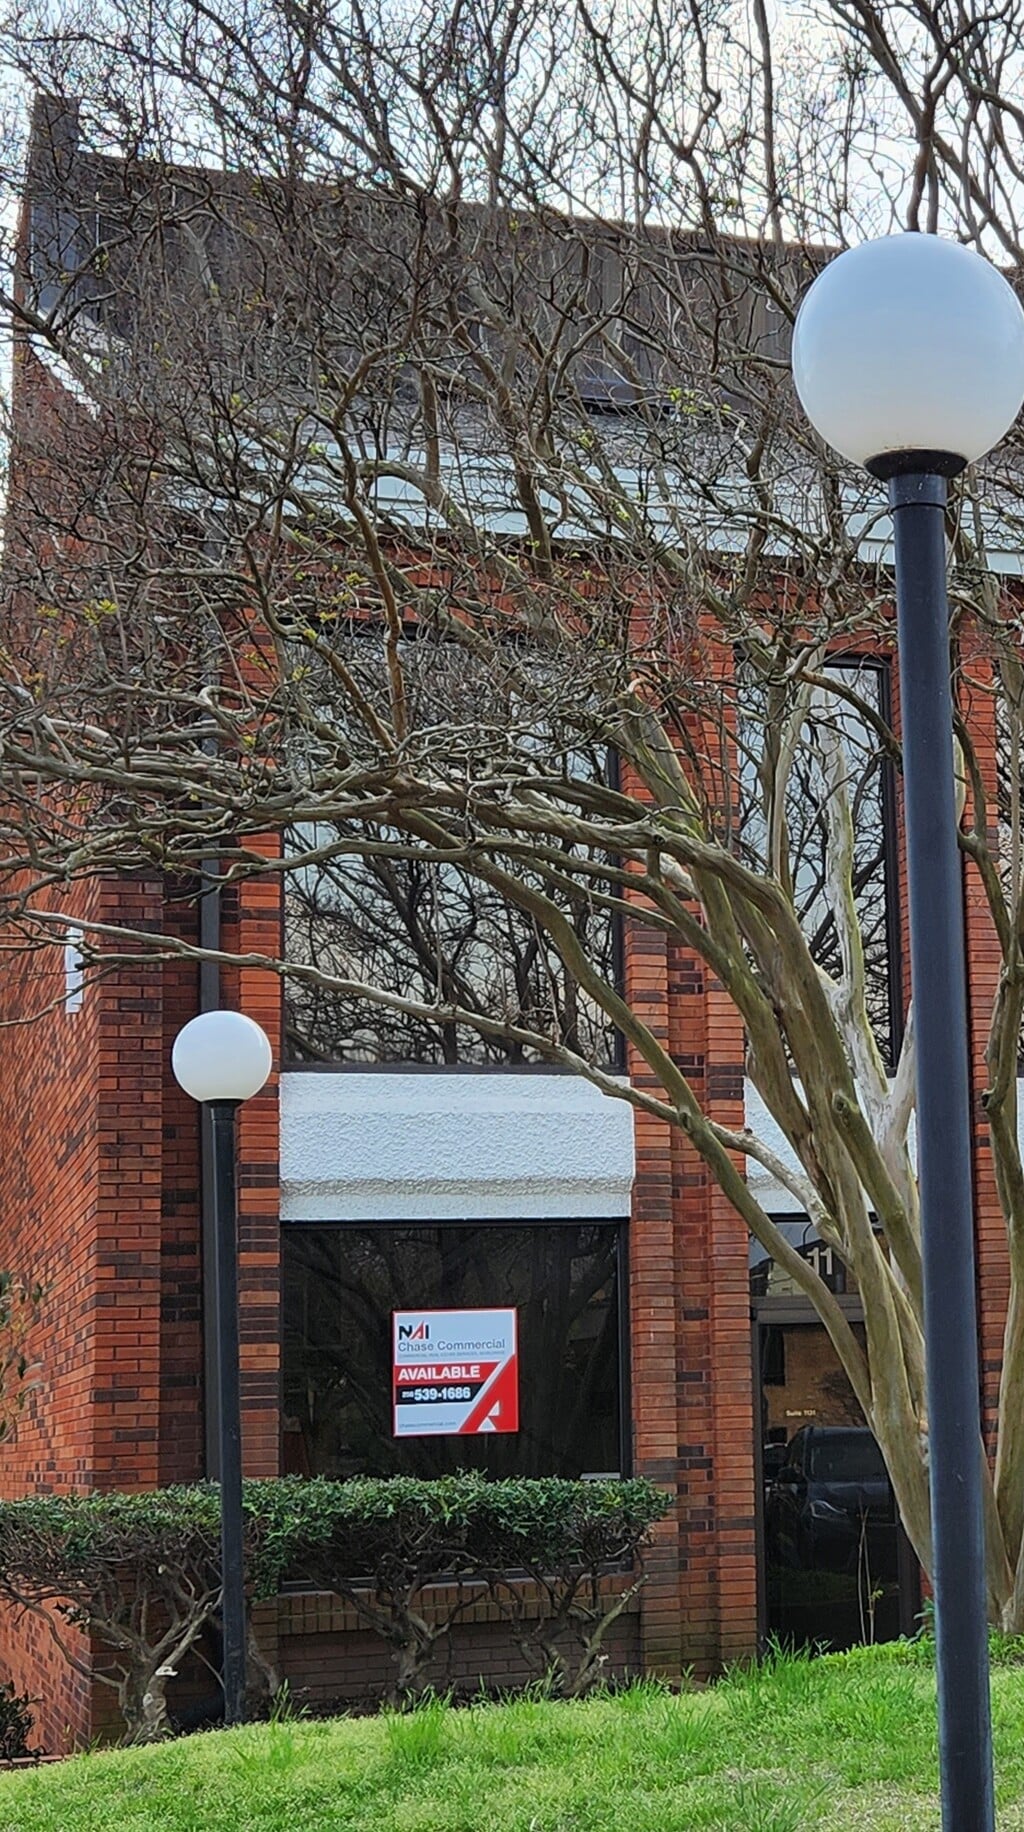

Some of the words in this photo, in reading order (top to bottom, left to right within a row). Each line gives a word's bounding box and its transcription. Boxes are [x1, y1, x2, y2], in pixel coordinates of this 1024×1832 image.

[399, 1321, 430, 1340] NAI
[398, 1342, 434, 1352] Chase
[437, 1339, 505, 1351] Commercial
[398, 1365, 481, 1381] AVAILABLE
